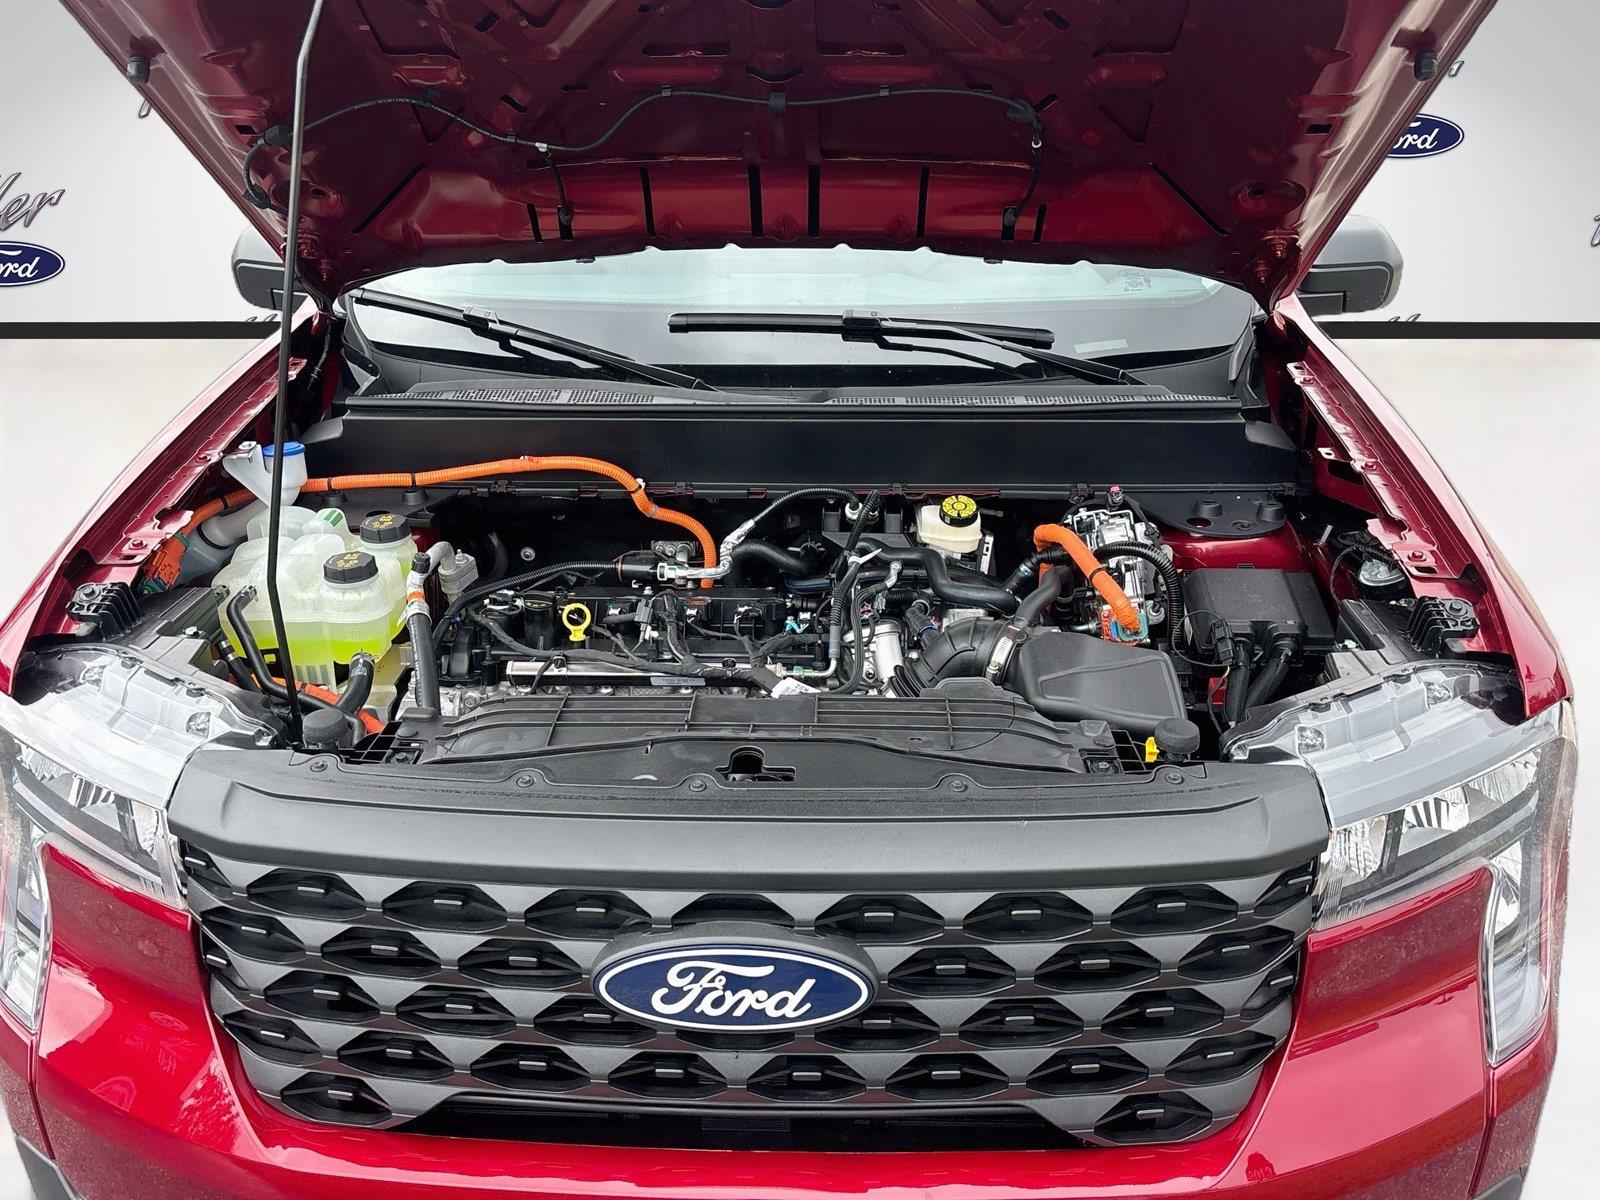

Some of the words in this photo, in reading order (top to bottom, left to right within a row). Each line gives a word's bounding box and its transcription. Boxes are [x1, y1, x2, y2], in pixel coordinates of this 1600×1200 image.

[1393, 121, 1440, 149] rd
[0, 250, 40, 278] rd
[651, 960, 817, 1018] Ford
